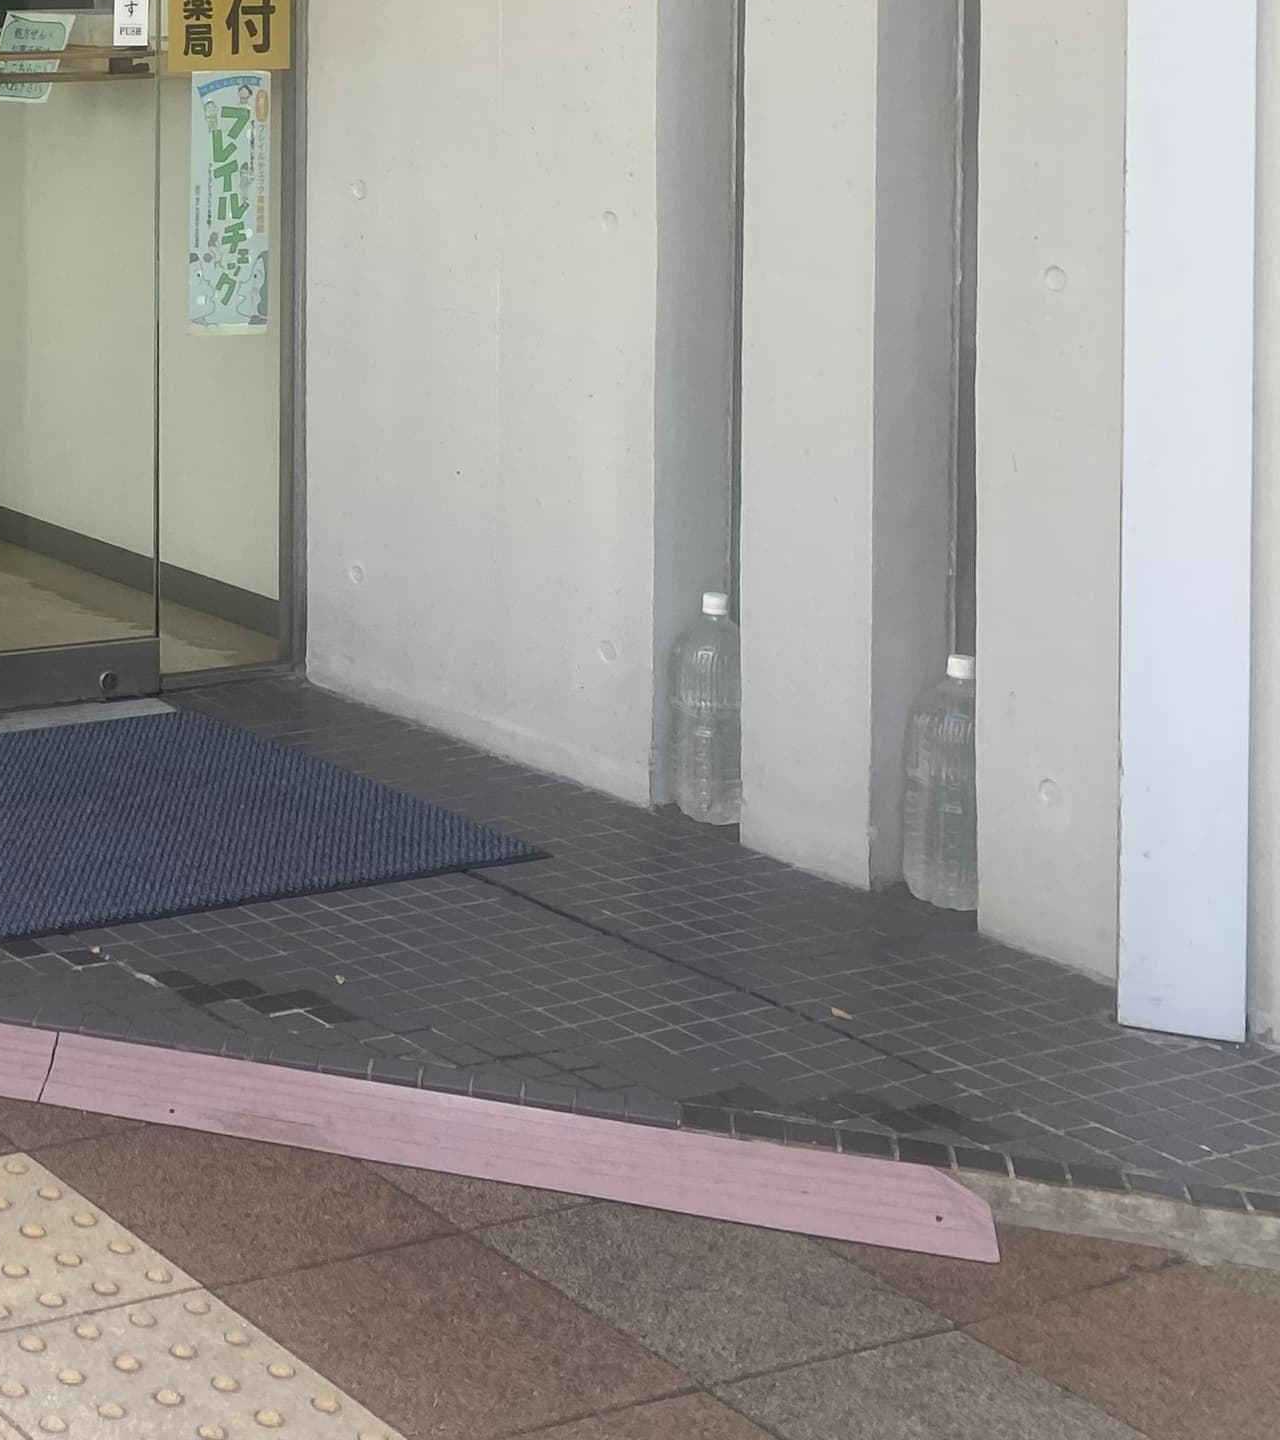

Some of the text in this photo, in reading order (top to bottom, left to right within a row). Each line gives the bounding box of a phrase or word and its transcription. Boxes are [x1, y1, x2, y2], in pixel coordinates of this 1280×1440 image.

[211, 105, 251, 307] フレイルチェック
